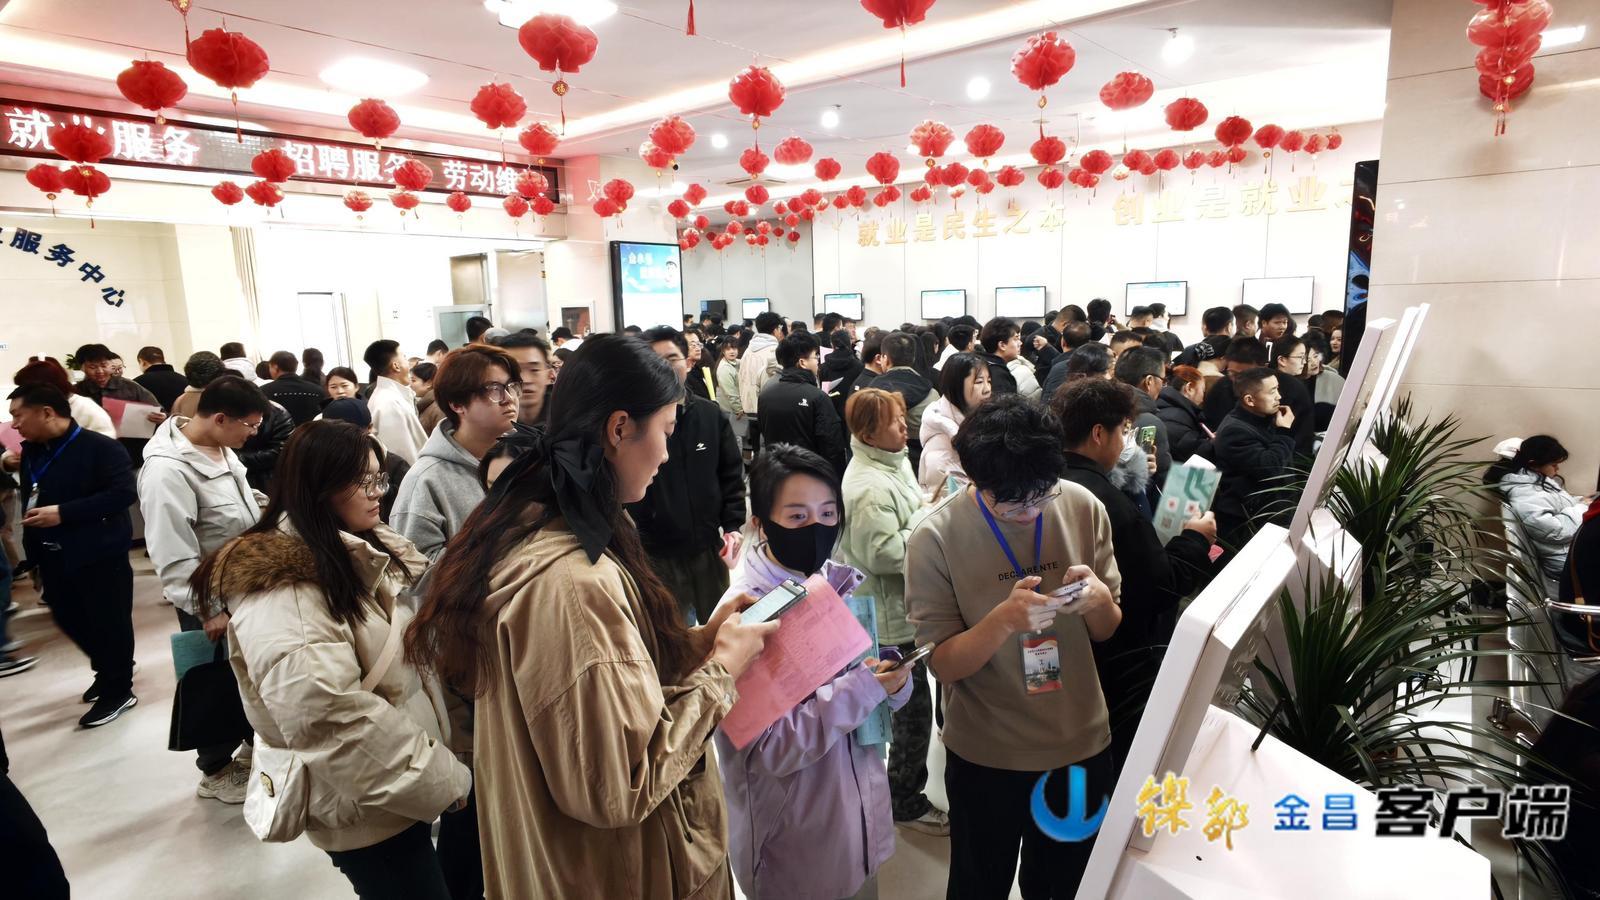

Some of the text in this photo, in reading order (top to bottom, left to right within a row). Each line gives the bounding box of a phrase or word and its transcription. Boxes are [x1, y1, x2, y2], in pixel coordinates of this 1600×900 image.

[5, 107, 200, 165] 就服务
[441, 160, 545, 196] 劳动维
[858, 202, 1067, 247] 就业是民生之本
[0, 227, 125, 307] 服务中心
[998, 560, 1059, 581] DECARENTE
